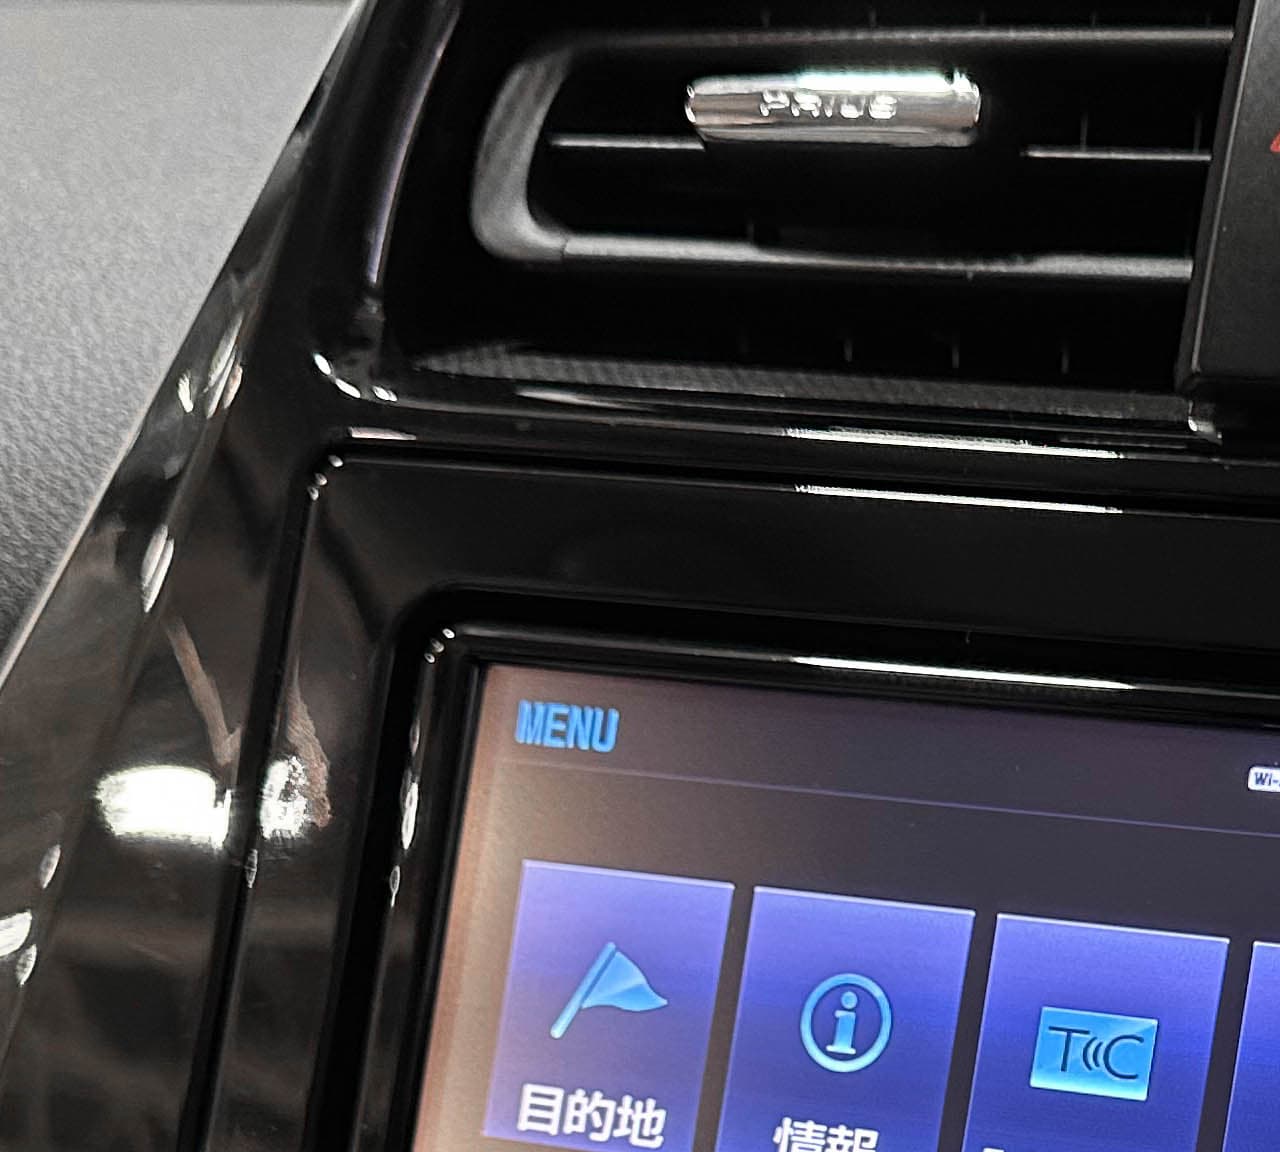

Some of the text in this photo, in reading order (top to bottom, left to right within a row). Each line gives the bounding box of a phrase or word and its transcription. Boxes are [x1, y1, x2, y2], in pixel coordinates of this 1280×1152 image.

[759, 89, 897, 120] PRIUS
[515, 698, 620, 753] MENU
[515, 1082, 667, 1150] 目的地
